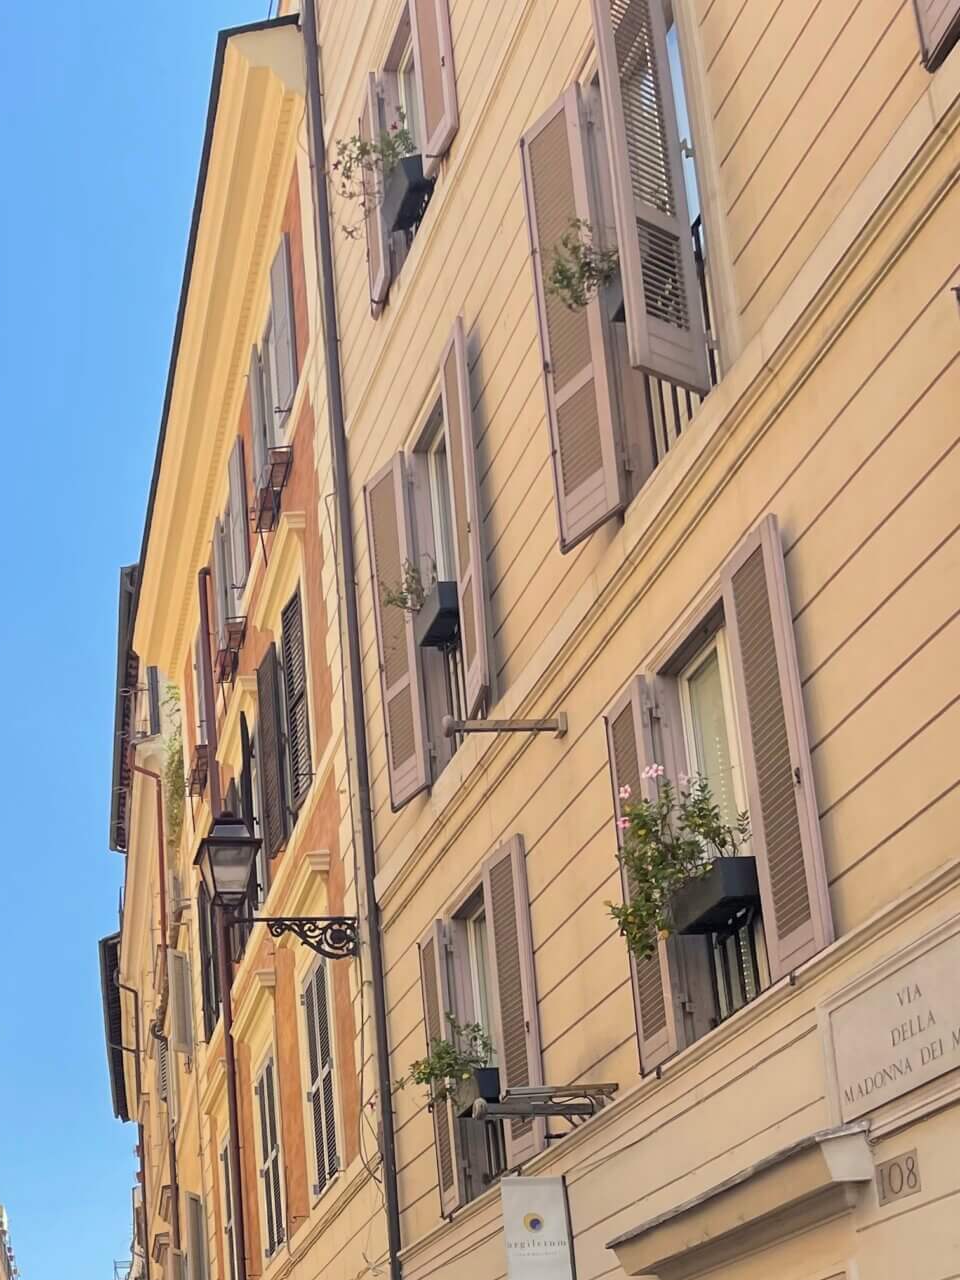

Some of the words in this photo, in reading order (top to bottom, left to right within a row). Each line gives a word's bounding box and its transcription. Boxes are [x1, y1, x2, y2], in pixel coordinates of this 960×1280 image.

[896, 983, 922, 1007] VIA
[890, 1009, 936, 1047] DELLA
[844, 1057, 913, 1104] MADONNA
[920, 1038, 944, 1065] DEI
[879, 1156, 919, 1200] 108
